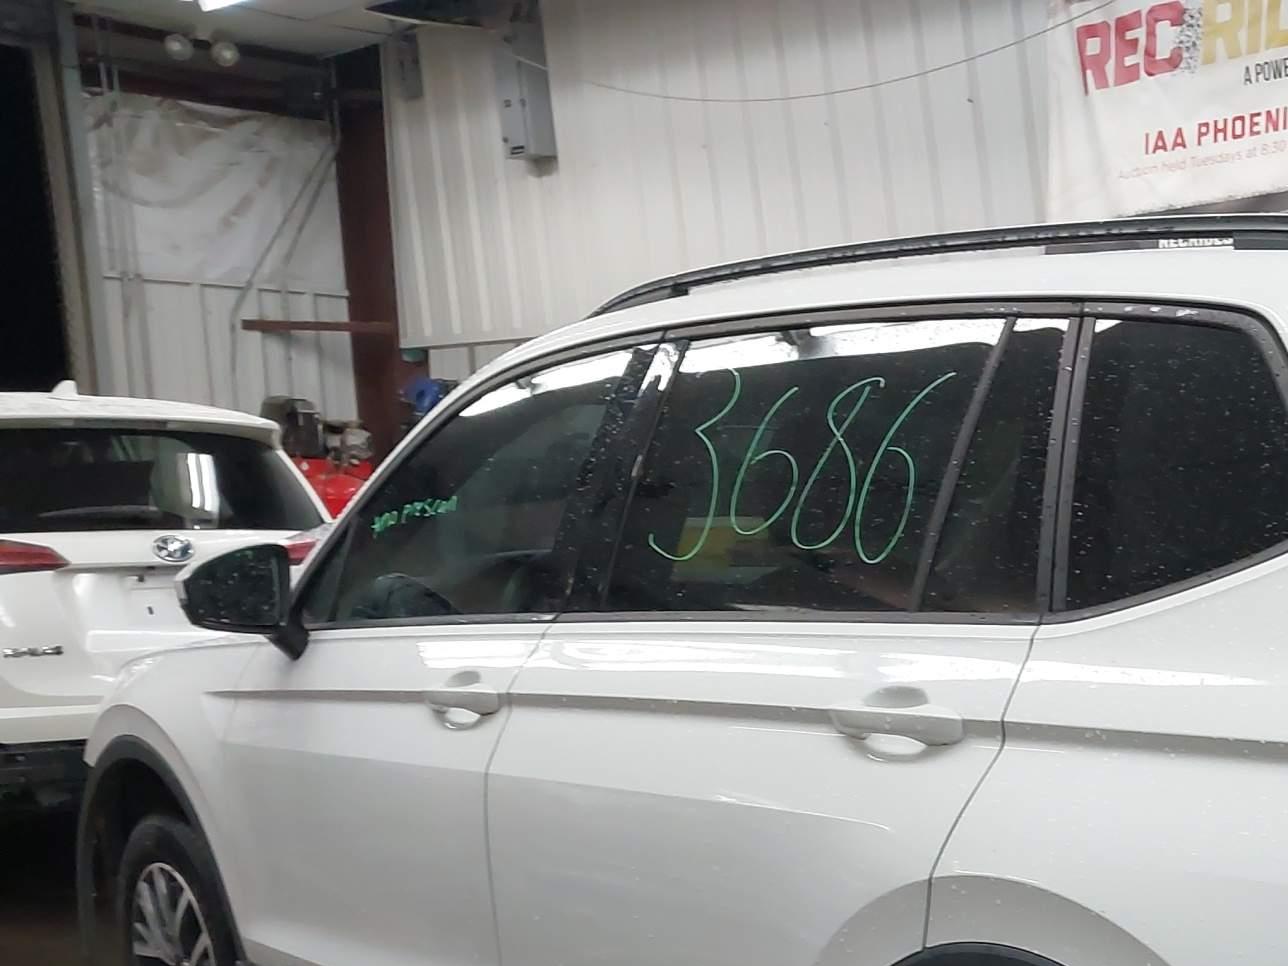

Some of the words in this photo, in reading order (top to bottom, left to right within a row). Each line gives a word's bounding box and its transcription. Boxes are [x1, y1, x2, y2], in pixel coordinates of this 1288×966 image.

[1076, 1, 1186, 95] REC
[1243, 66, 1253, 85] A
[1144, 127, 1187, 155] IAA
[1189, 151, 1242, 168] Tuesdays
[1245, 145, 1258, 158] at
[648, 368, 957, 565] 3686
